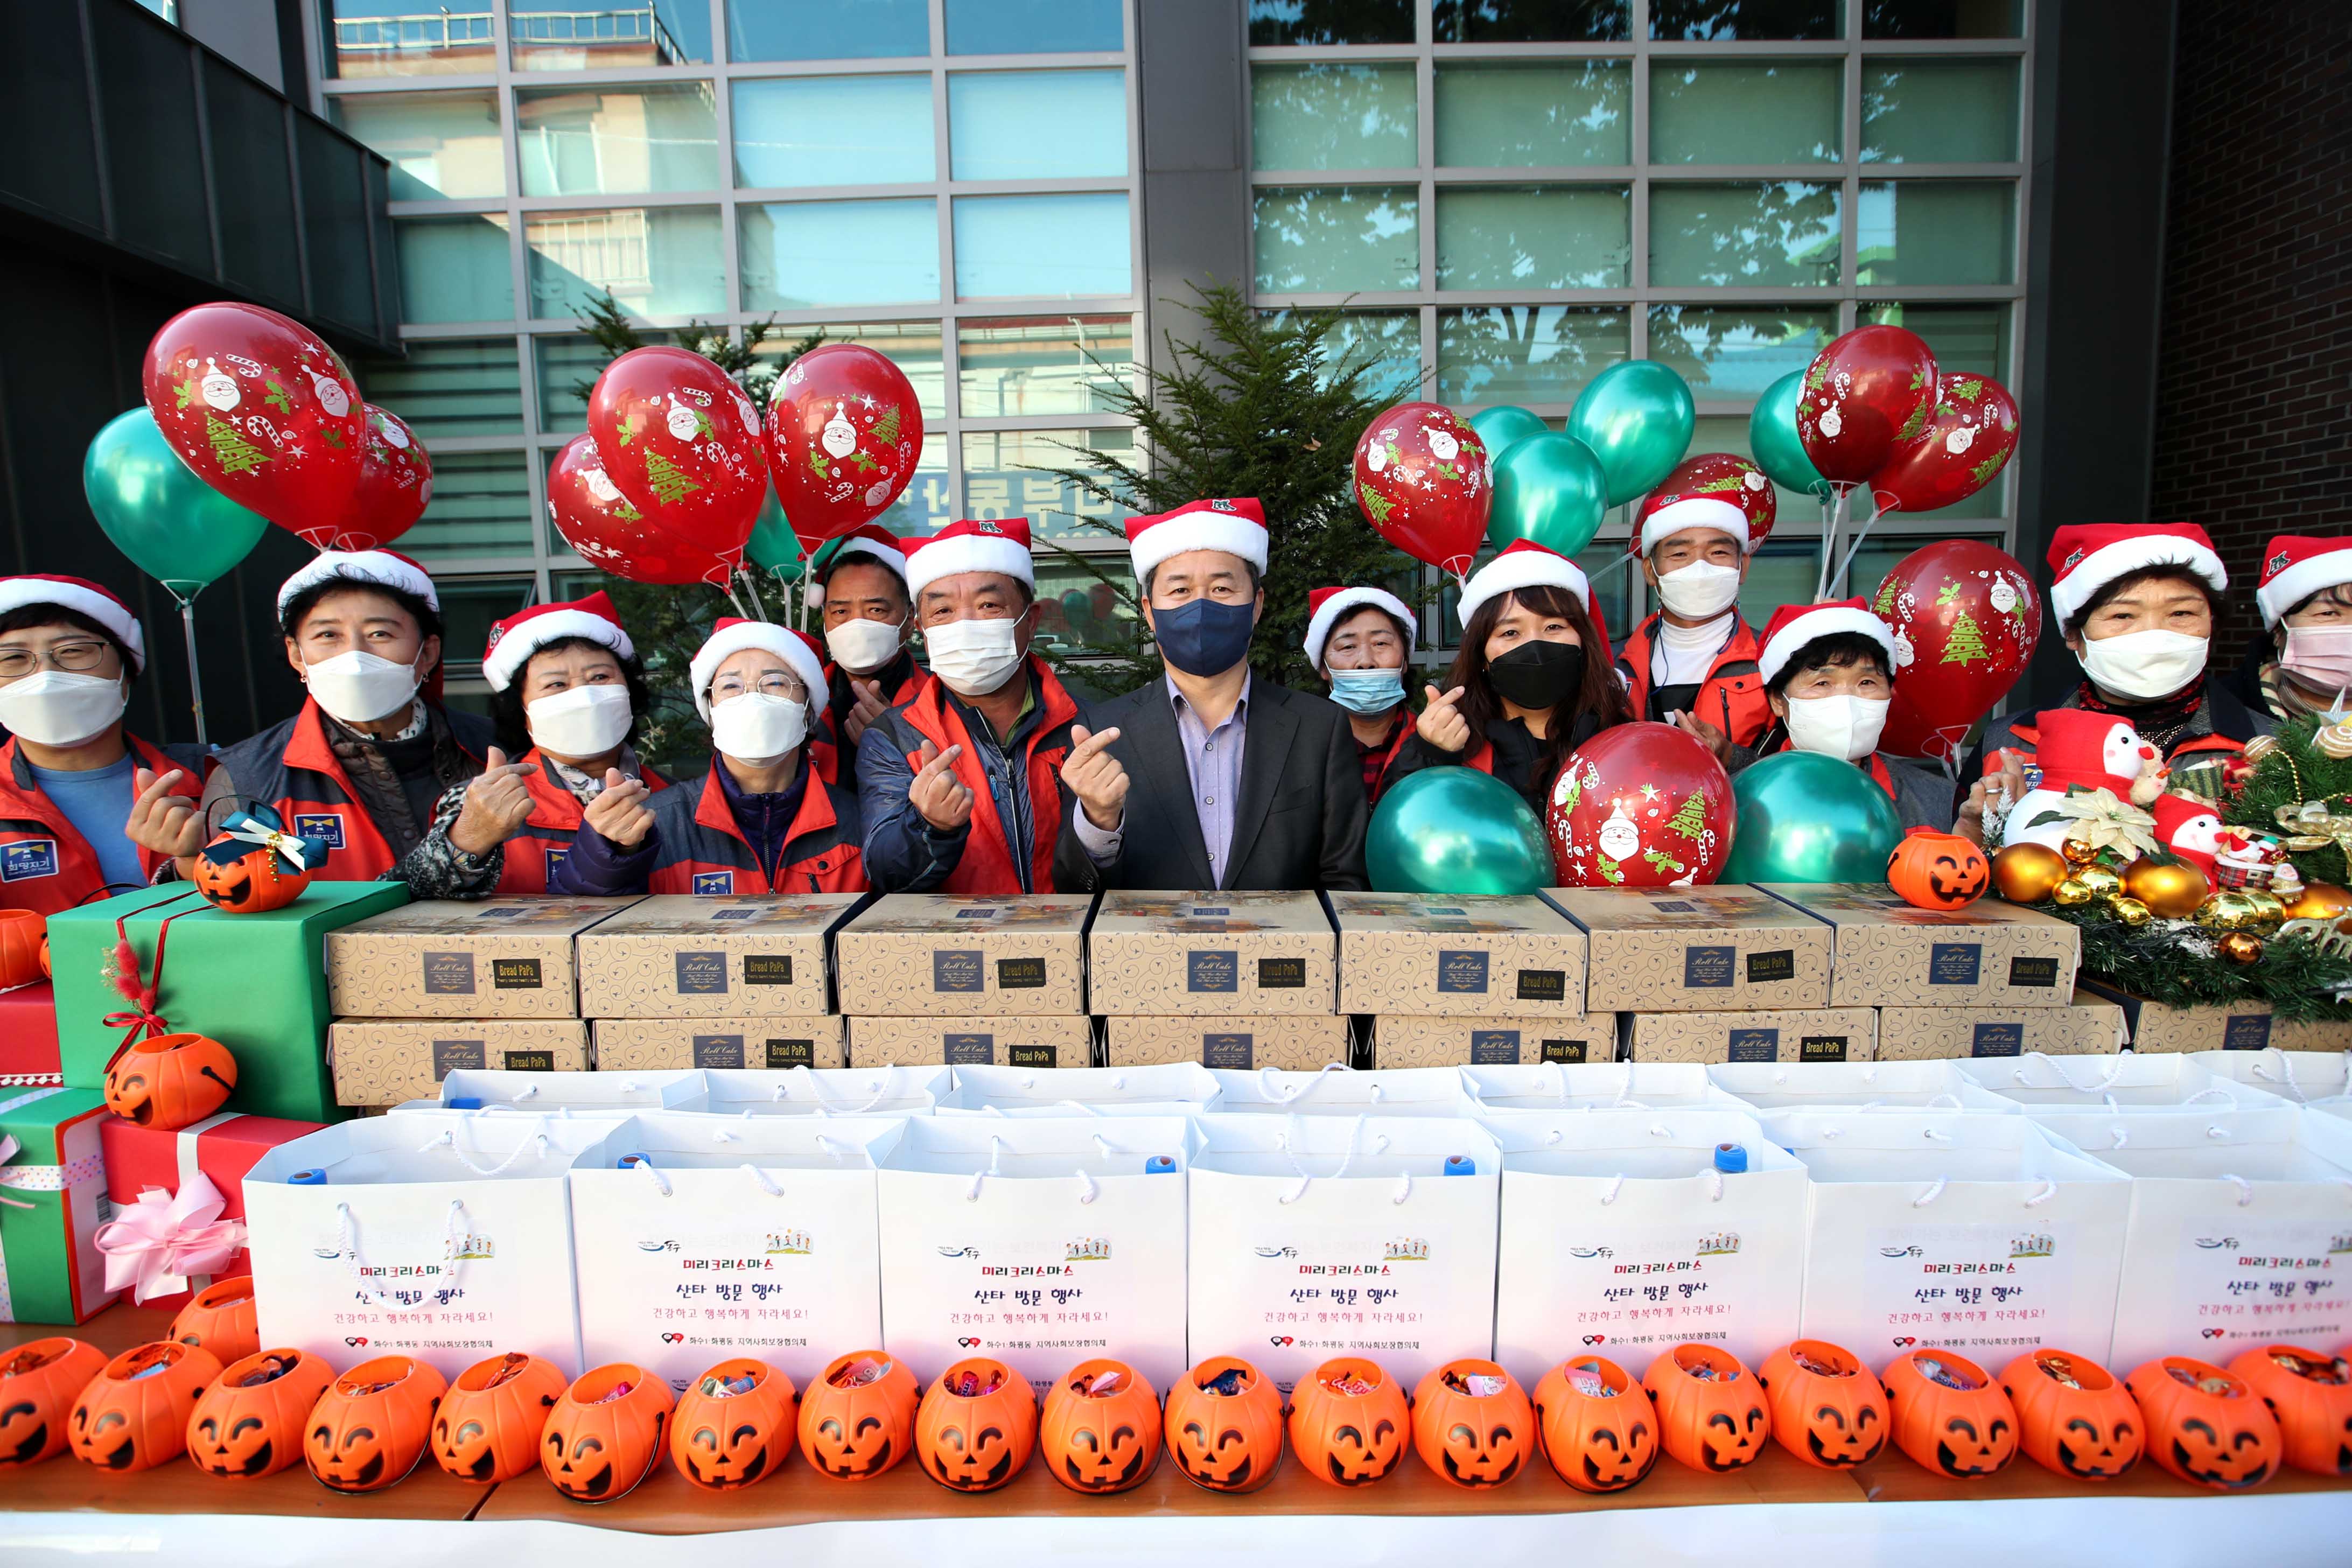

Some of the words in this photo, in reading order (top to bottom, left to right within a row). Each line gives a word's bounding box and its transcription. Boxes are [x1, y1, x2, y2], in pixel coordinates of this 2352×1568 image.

[8, 856, 49, 871] 희망지기
[750, 961, 767, 972] Bread
[770, 961, 784, 972] PaPa
[1753, 960, 1769, 970] Bread
[1772, 957, 1786, 968] PaPa
[500, 965, 517, 976] Bread
[519, 965, 534, 976] PaPa
[1004, 965, 1022, 976] Bread
[1524, 976, 1540, 988] Bread
[1543, 976, 1557, 988] PaPa
[772, 1045, 790, 1056] Bread
[792, 1045, 806, 1056] PaPa
[1547, 1046, 1563, 1056] Bread
[1566, 1046, 1579, 1056] PaPa
[1806, 1042, 1823, 1053] Bread
[1825, 1042, 1839, 1053] PaPa
[440, 1052, 462, 1060] Roll
[461, 1052, 479, 1060] Cake
[1016, 1051, 1033, 1061] Bread
[1034, 1051, 1048, 1061] PaPa
[512, 1057, 528, 1068] Bread
[530, 1057, 546, 1068] PaPa
[663, 1241, 681, 1252] 동구
[344, 1248, 358, 1261] 구
[963, 1247, 980, 1259] 동구
[1280, 1247, 1298, 1259] 동구
[1596, 1247, 1614, 1259] 동구
[683, 1259, 773, 1271] 미리크리스마스
[1614, 1261, 1702, 1274] 미리크리스마스
[1924, 1263, 2015, 1275] 미리크리스마스
[2239, 1256, 2332, 1270] 미리크리스마스
[982, 1265, 1073, 1277] 미리크리스마스
[1299, 1265, 1390, 1276] 미리크리스마스
[676, 1284, 706, 1298] 산타
[716, 1284, 742, 1301] 방문
[752, 1284, 782, 1300] 행사
[1604, 1288, 1635, 1301] 산타
[1644, 1286, 1669, 1301] 방문
[1678, 1283, 1708, 1298] 행사
[2228, 1280, 2260, 1295] 산타
[2269, 1281, 2295, 1297] 방문
[974, 1290, 1005, 1304] 산타
[1015, 1290, 1041, 1306] 방문
[1051, 1289, 1082, 1304] 행사
[1290, 1289, 1321, 1303] 산타
[1331, 1289, 1357, 1305] 방문
[1367, 1289, 1398, 1304] 행사
[1915, 1289, 1947, 1303] 산타
[1956, 1287, 1982, 1304] 방문
[1991, 1286, 2023, 1302] 행사
[334, 1313, 380, 1325] 건강하고
[387, 1312, 433, 1325] 행복하게
[440, 1312, 493, 1324] 자라세요!
[653, 1308, 697, 1319] 건강하고
[705, 1308, 749, 1320] 행복하게
[758, 1310, 807, 1320] 자라세요!
[950, 1313, 995, 1324] 건강하고
[1003, 1313, 1048, 1324] 행복하게
[1057, 1312, 1107, 1322] 자라세요!
[1265, 1312, 1308, 1322] 건강하고
[1318, 1312, 1363, 1322] 행복하게
[1372, 1313, 1422, 1323] 자라세요!
[1578, 1311, 1621, 1322] 건강하고
[1629, 1307, 1673, 1320] 행복하게
[1681, 1305, 1730, 1316] 자라세요!
[1888, 1312, 1933, 1324] 건강하고
[1940, 1310, 1986, 1322] 행복하게
[1996, 1308, 2045, 1320] 자라세요!
[738, 1338, 807, 1346] 지역사회보장협의체
[1658, 1332, 1726, 1343] 지역사회보장협의체
[1036, 1340, 1105, 1348] 지역사회보장협의체
[1349, 1341, 1419, 1350] 지역사회보장협의체
